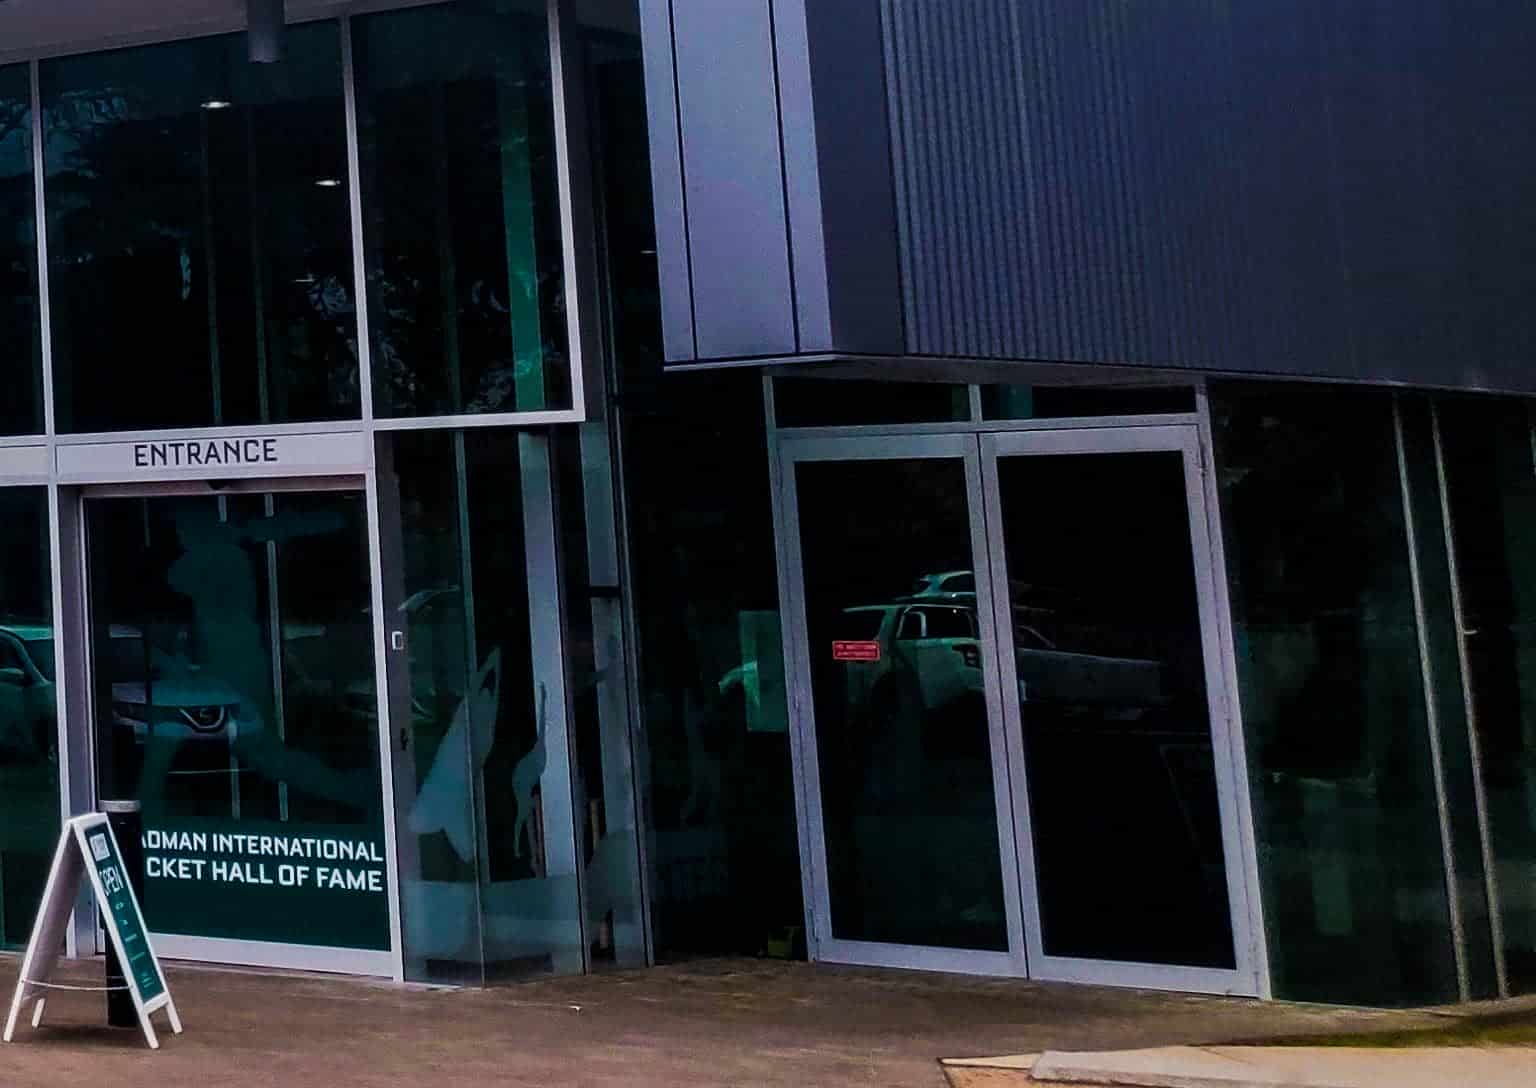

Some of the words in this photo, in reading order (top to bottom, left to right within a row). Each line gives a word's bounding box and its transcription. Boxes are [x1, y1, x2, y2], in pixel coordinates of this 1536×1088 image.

[134, 438, 278, 467] ENTRANCE
[141, 830, 207, 852] DMAN
[212, 833, 384, 862] INTERNATIONAL
[146, 857, 207, 880] CKET
[212, 861, 273, 885] HALL
[278, 864, 310, 887] OF
[316, 867, 384, 892] FAME
